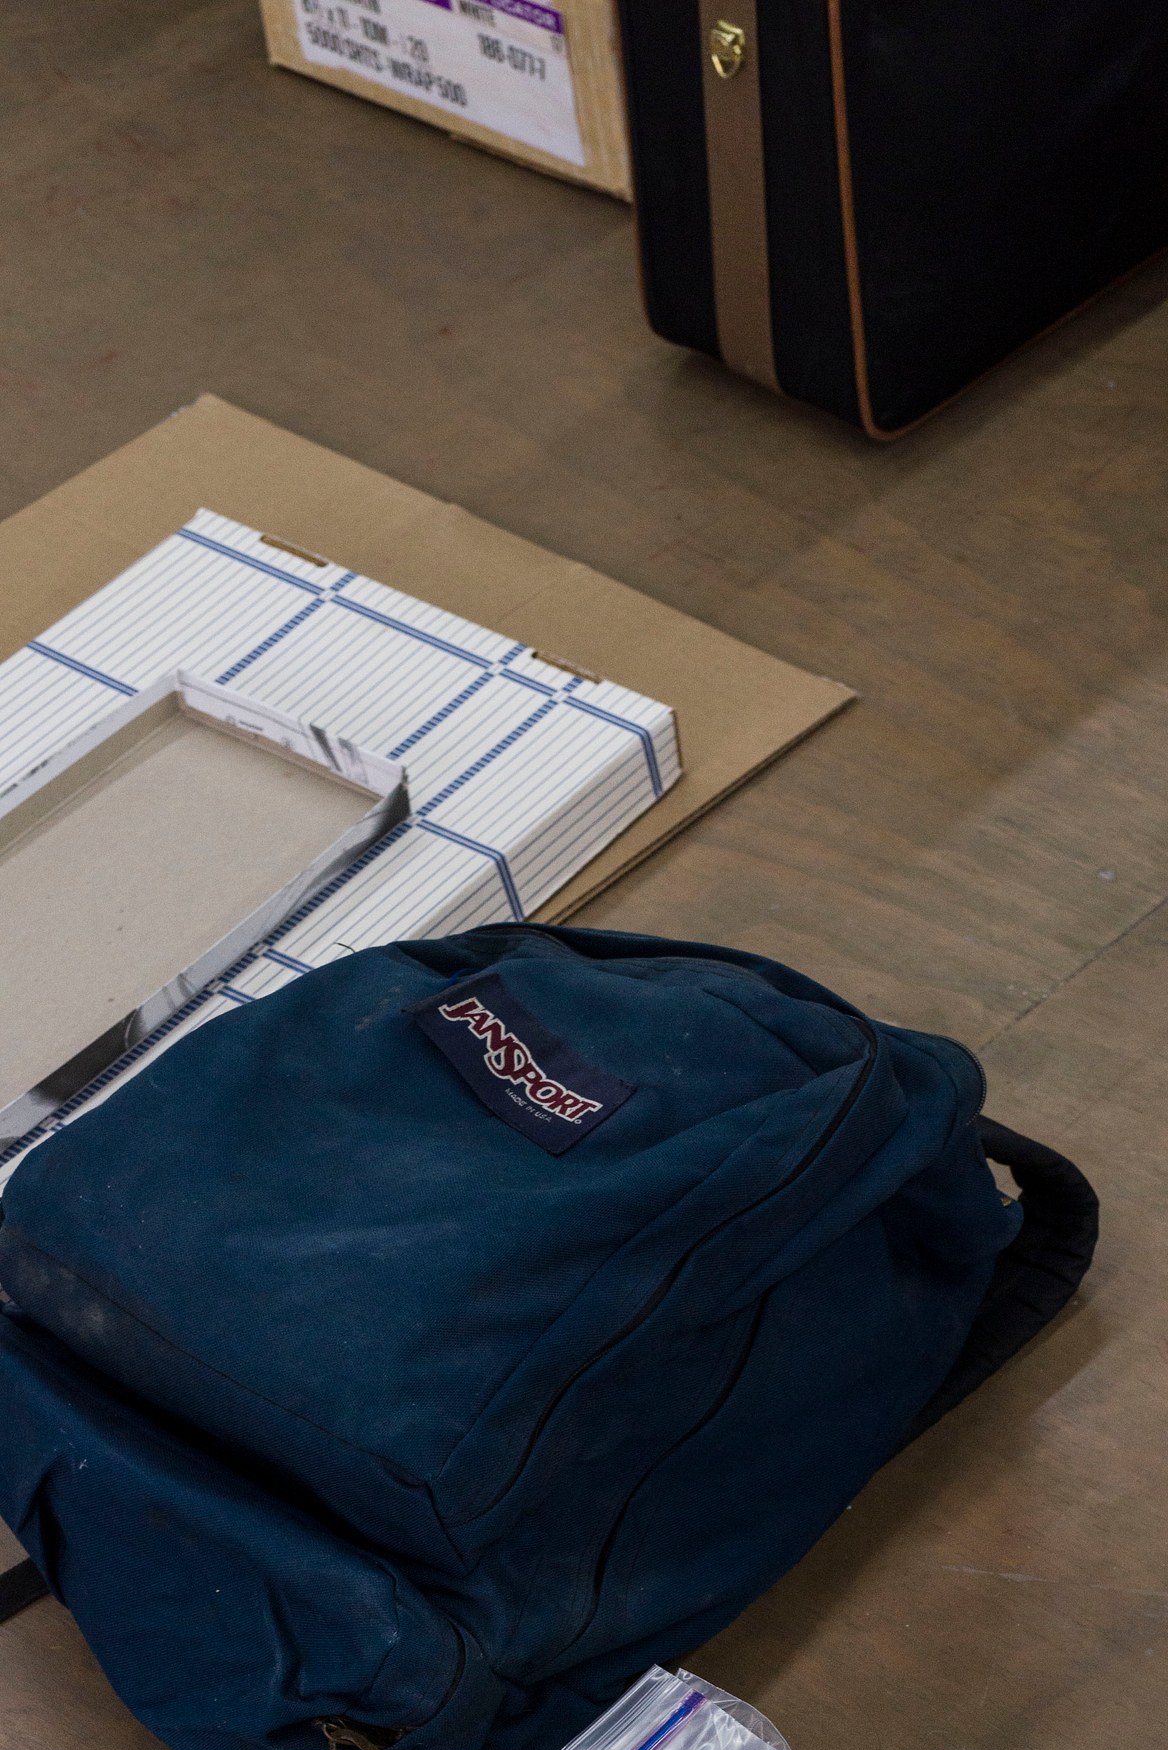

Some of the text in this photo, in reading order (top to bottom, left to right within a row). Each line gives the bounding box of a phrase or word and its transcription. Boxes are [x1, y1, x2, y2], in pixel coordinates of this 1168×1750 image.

[438, 997, 603, 1123] JANSPORT
[505, 1088, 528, 1107] MADE
[534, 1110, 553, 1123] USA
